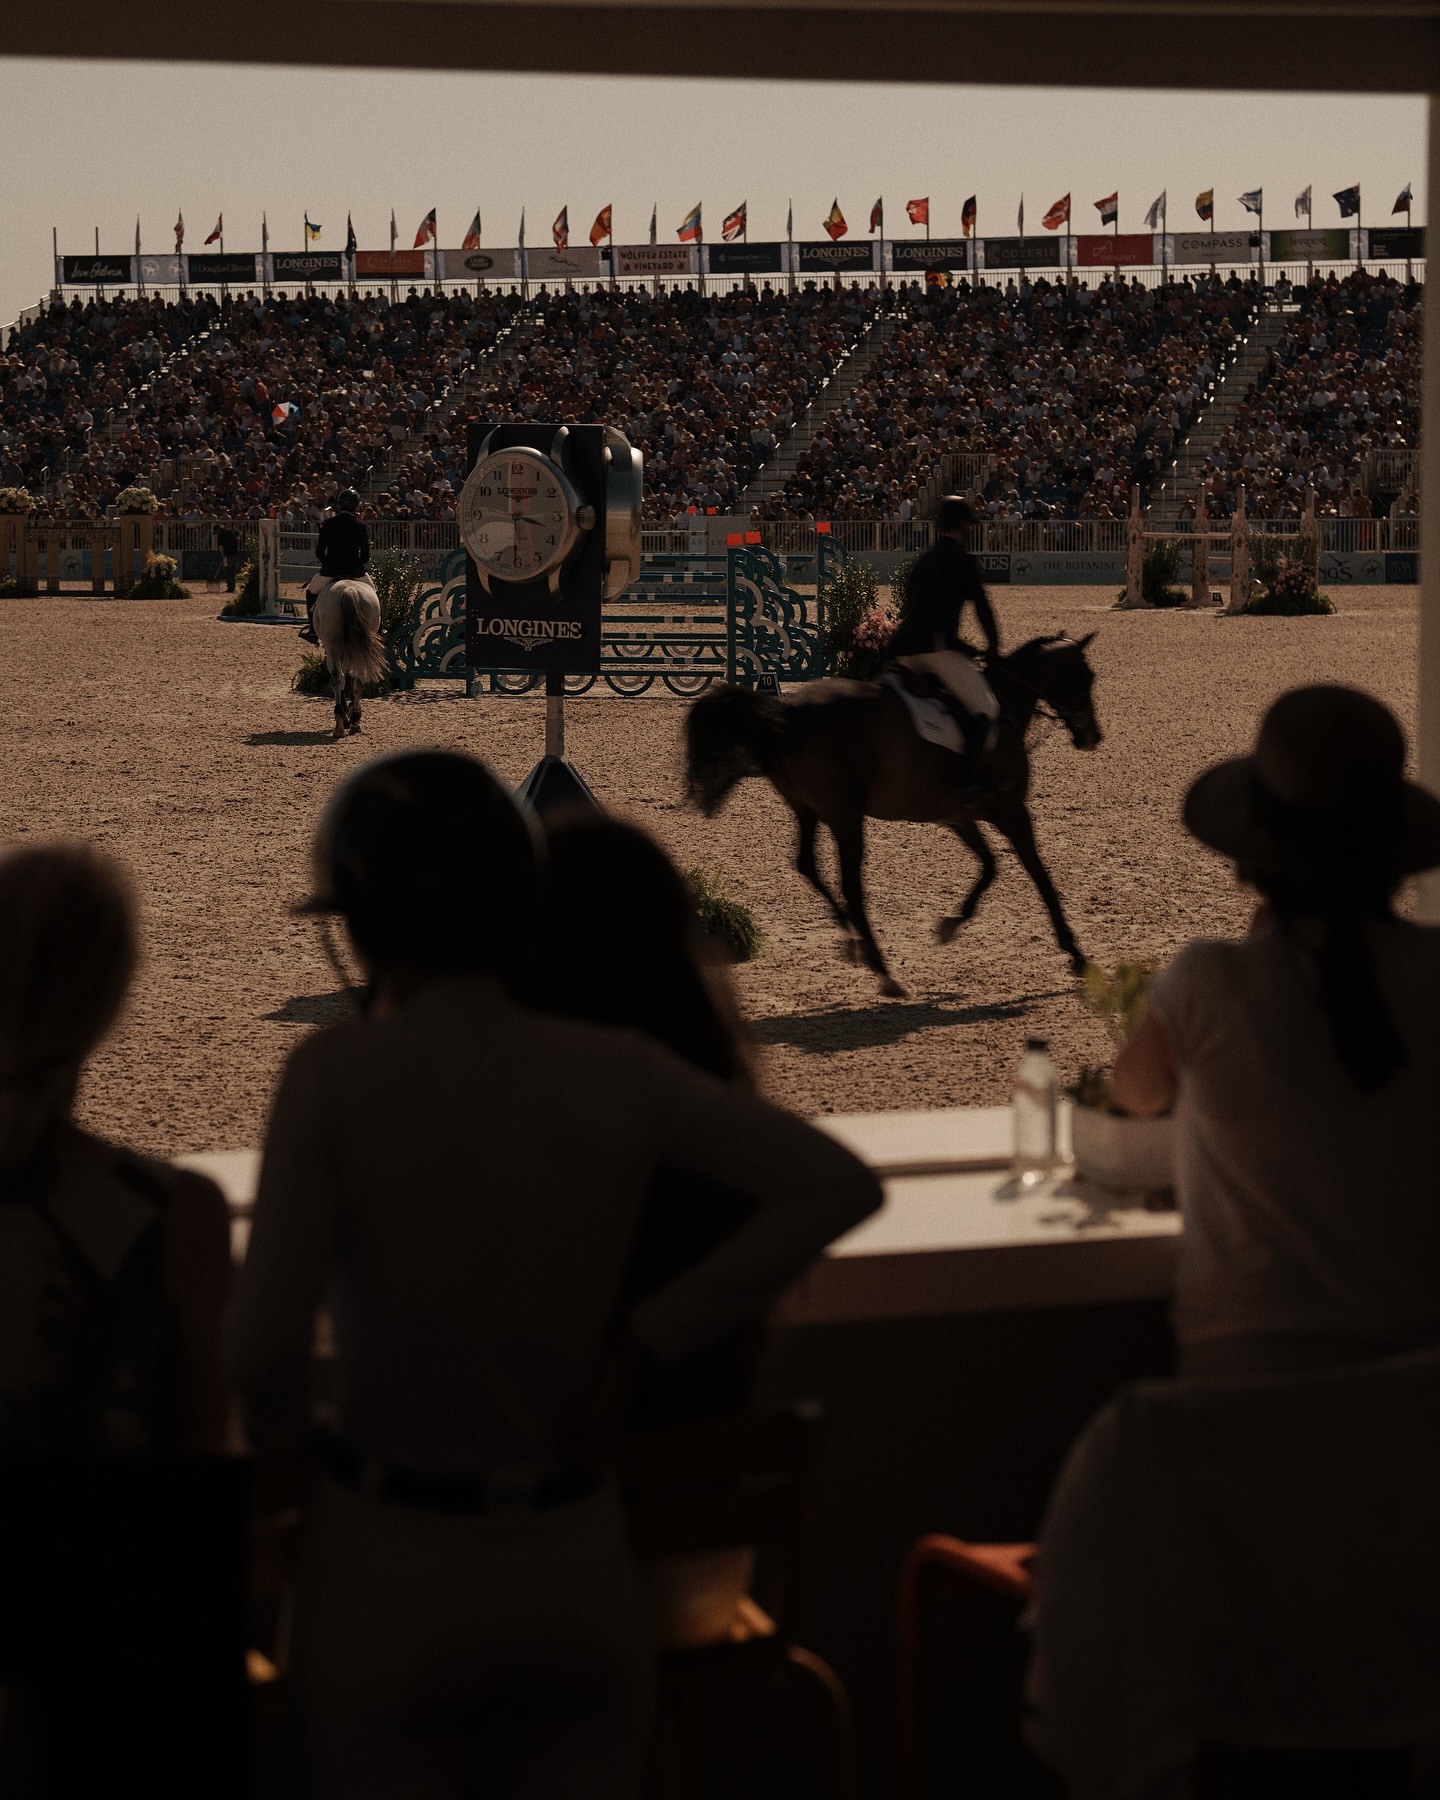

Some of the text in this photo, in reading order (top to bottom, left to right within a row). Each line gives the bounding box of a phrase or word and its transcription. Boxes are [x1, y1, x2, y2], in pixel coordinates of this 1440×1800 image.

[1182, 239, 1242, 250] COMPASS
[659, 250, 687, 259] ESTATE
[802, 247, 869, 258] LONGINES
[896, 247, 963, 258] LONGINES
[277, 257, 338, 269] LONGINES
[634, 262, 673, 270] VINEYARD
[511, 464, 523, 475] 12
[494, 470, 502, 480] 11
[536, 471, 540, 481] 1
[479, 486, 491, 497] 10
[497, 487, 537, 495] LONGINES
[547, 488, 556, 497] 2
[473, 510, 482, 520] 9
[552, 511, 562, 522] 3
[479, 533, 489, 543] 8
[546, 535, 556, 546] 4
[495, 551, 503, 561] 7
[533, 552, 542, 562] 5
[476, 618, 582, 639] LONGINES
[762, 676, 772, 686] 10
